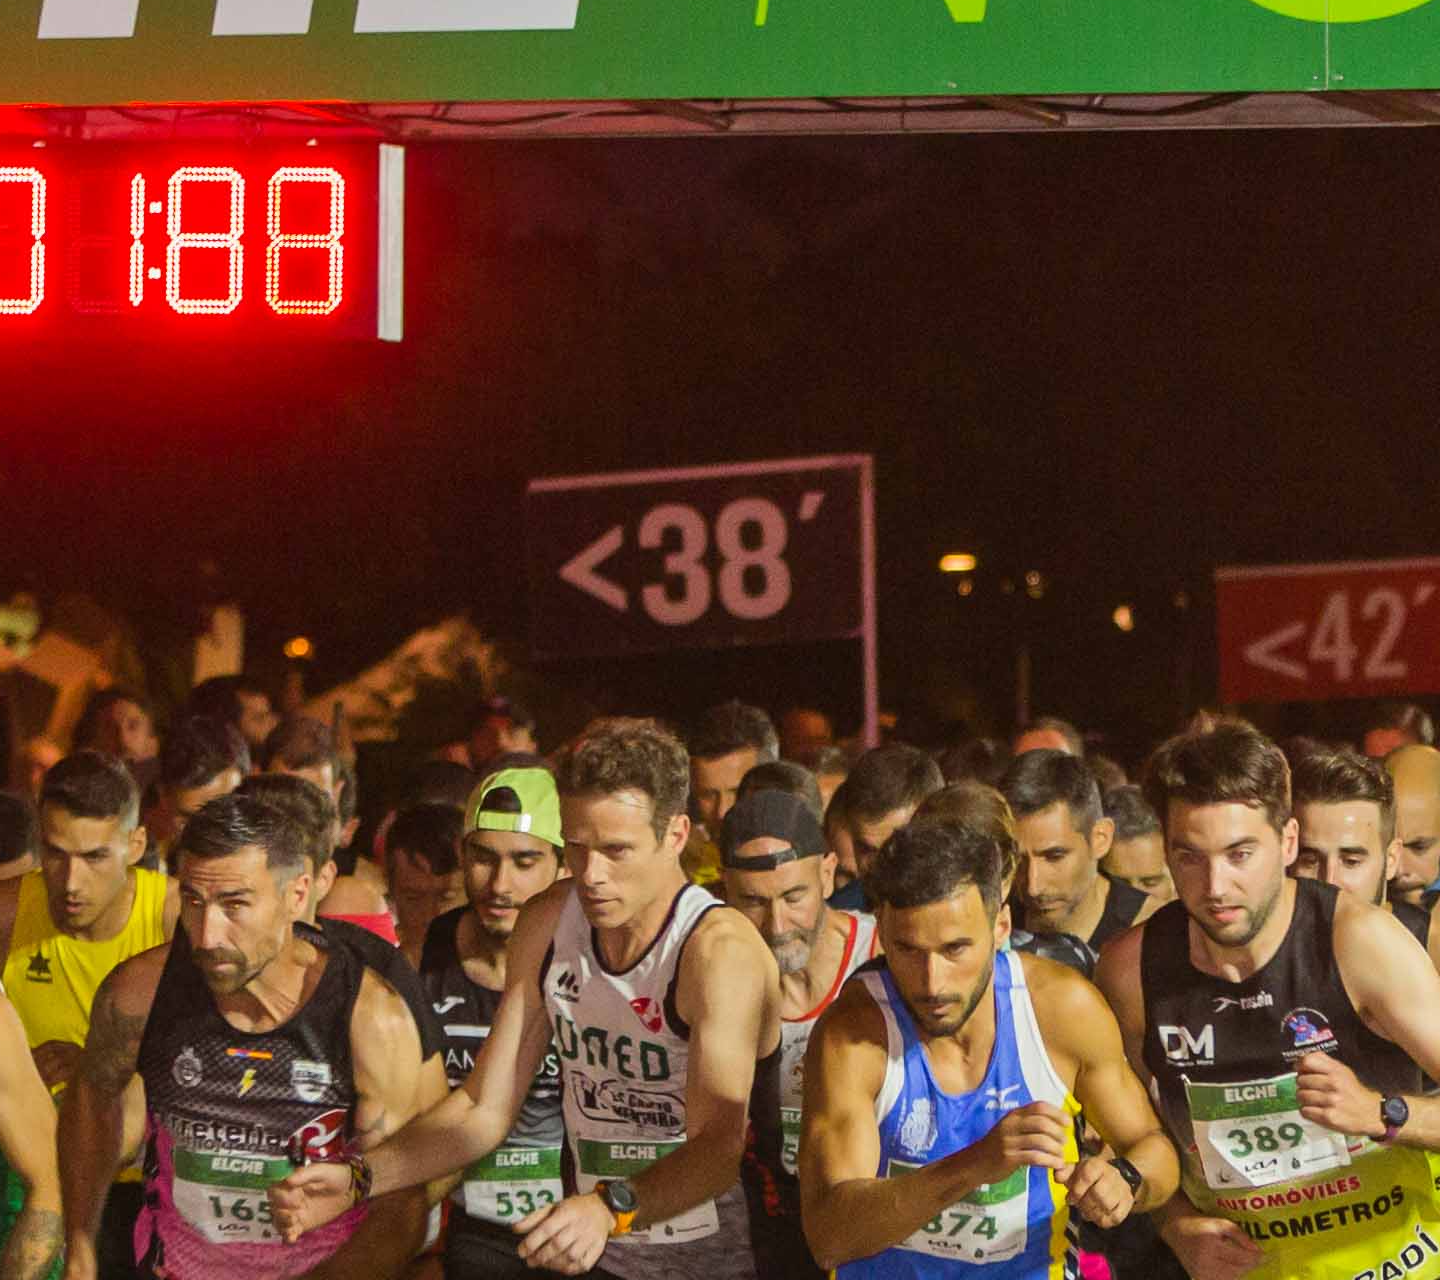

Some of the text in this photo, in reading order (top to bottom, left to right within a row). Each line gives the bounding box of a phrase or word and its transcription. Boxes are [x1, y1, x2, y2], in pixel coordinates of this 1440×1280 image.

[1223, 1084, 1278, 1103] ELCHE
[1226, 1122, 1305, 1159] 389
[495, 1150, 541, 1167] ELCHE
[609, 1144, 658, 1161] ELCHE
[210, 1158, 265, 1176] ELCHE
[1215, 1175, 1362, 1212] AUTOMÓVILES
